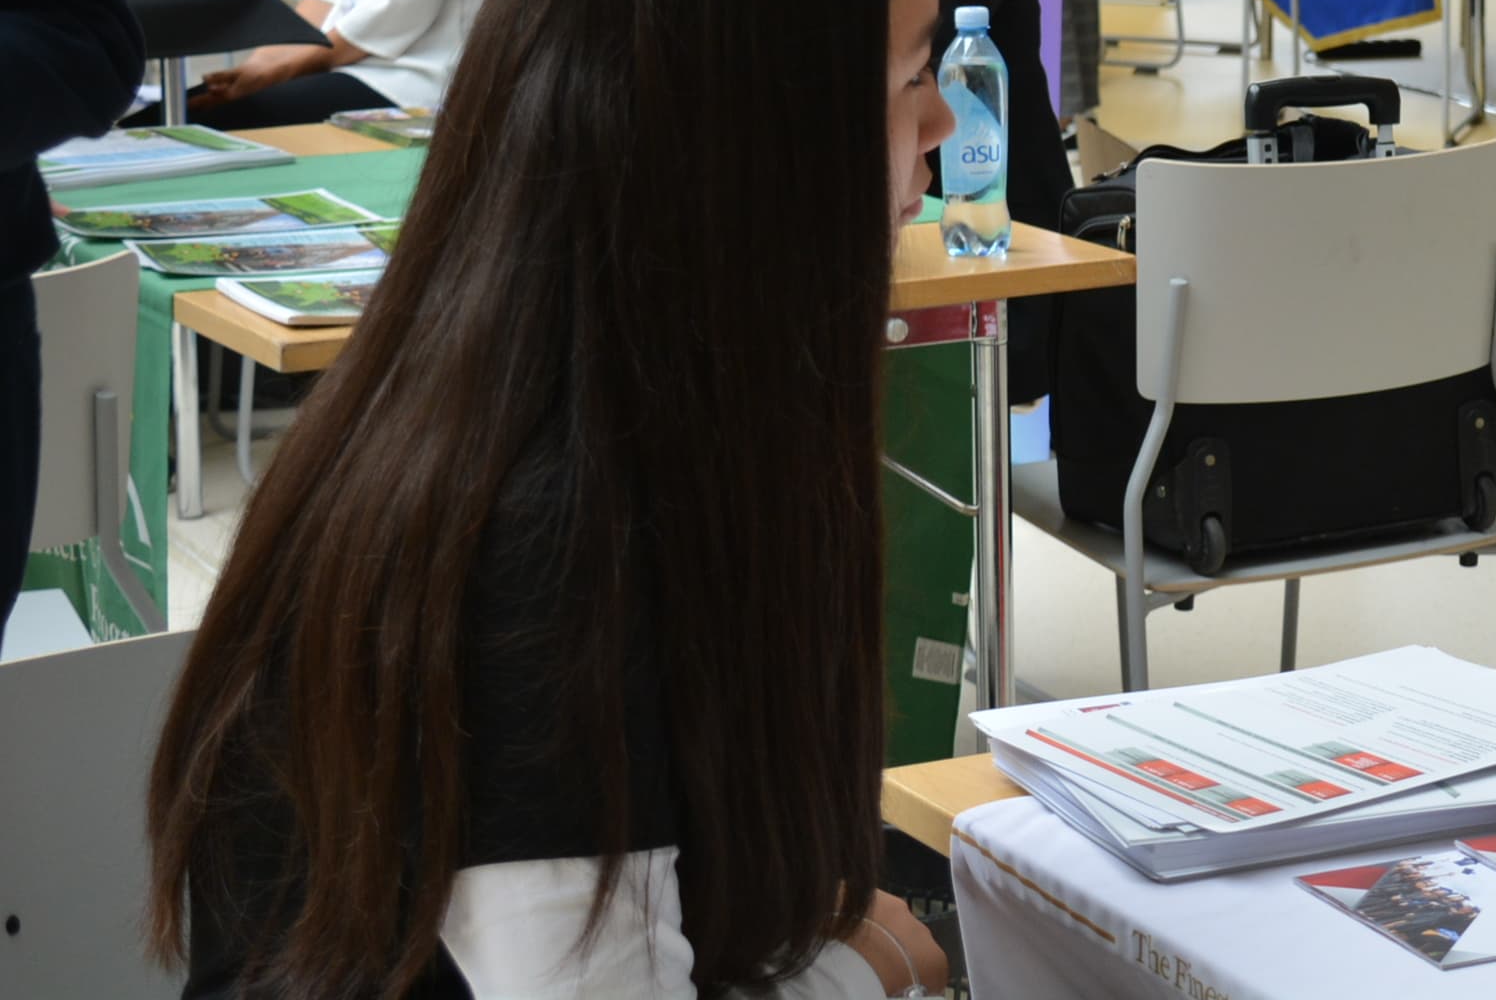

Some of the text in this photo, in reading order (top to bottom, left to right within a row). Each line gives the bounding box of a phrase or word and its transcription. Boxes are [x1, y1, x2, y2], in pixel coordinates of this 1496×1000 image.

[961, 143, 1000, 165] asu
[1132, 928, 1233, 1000] The Fine
